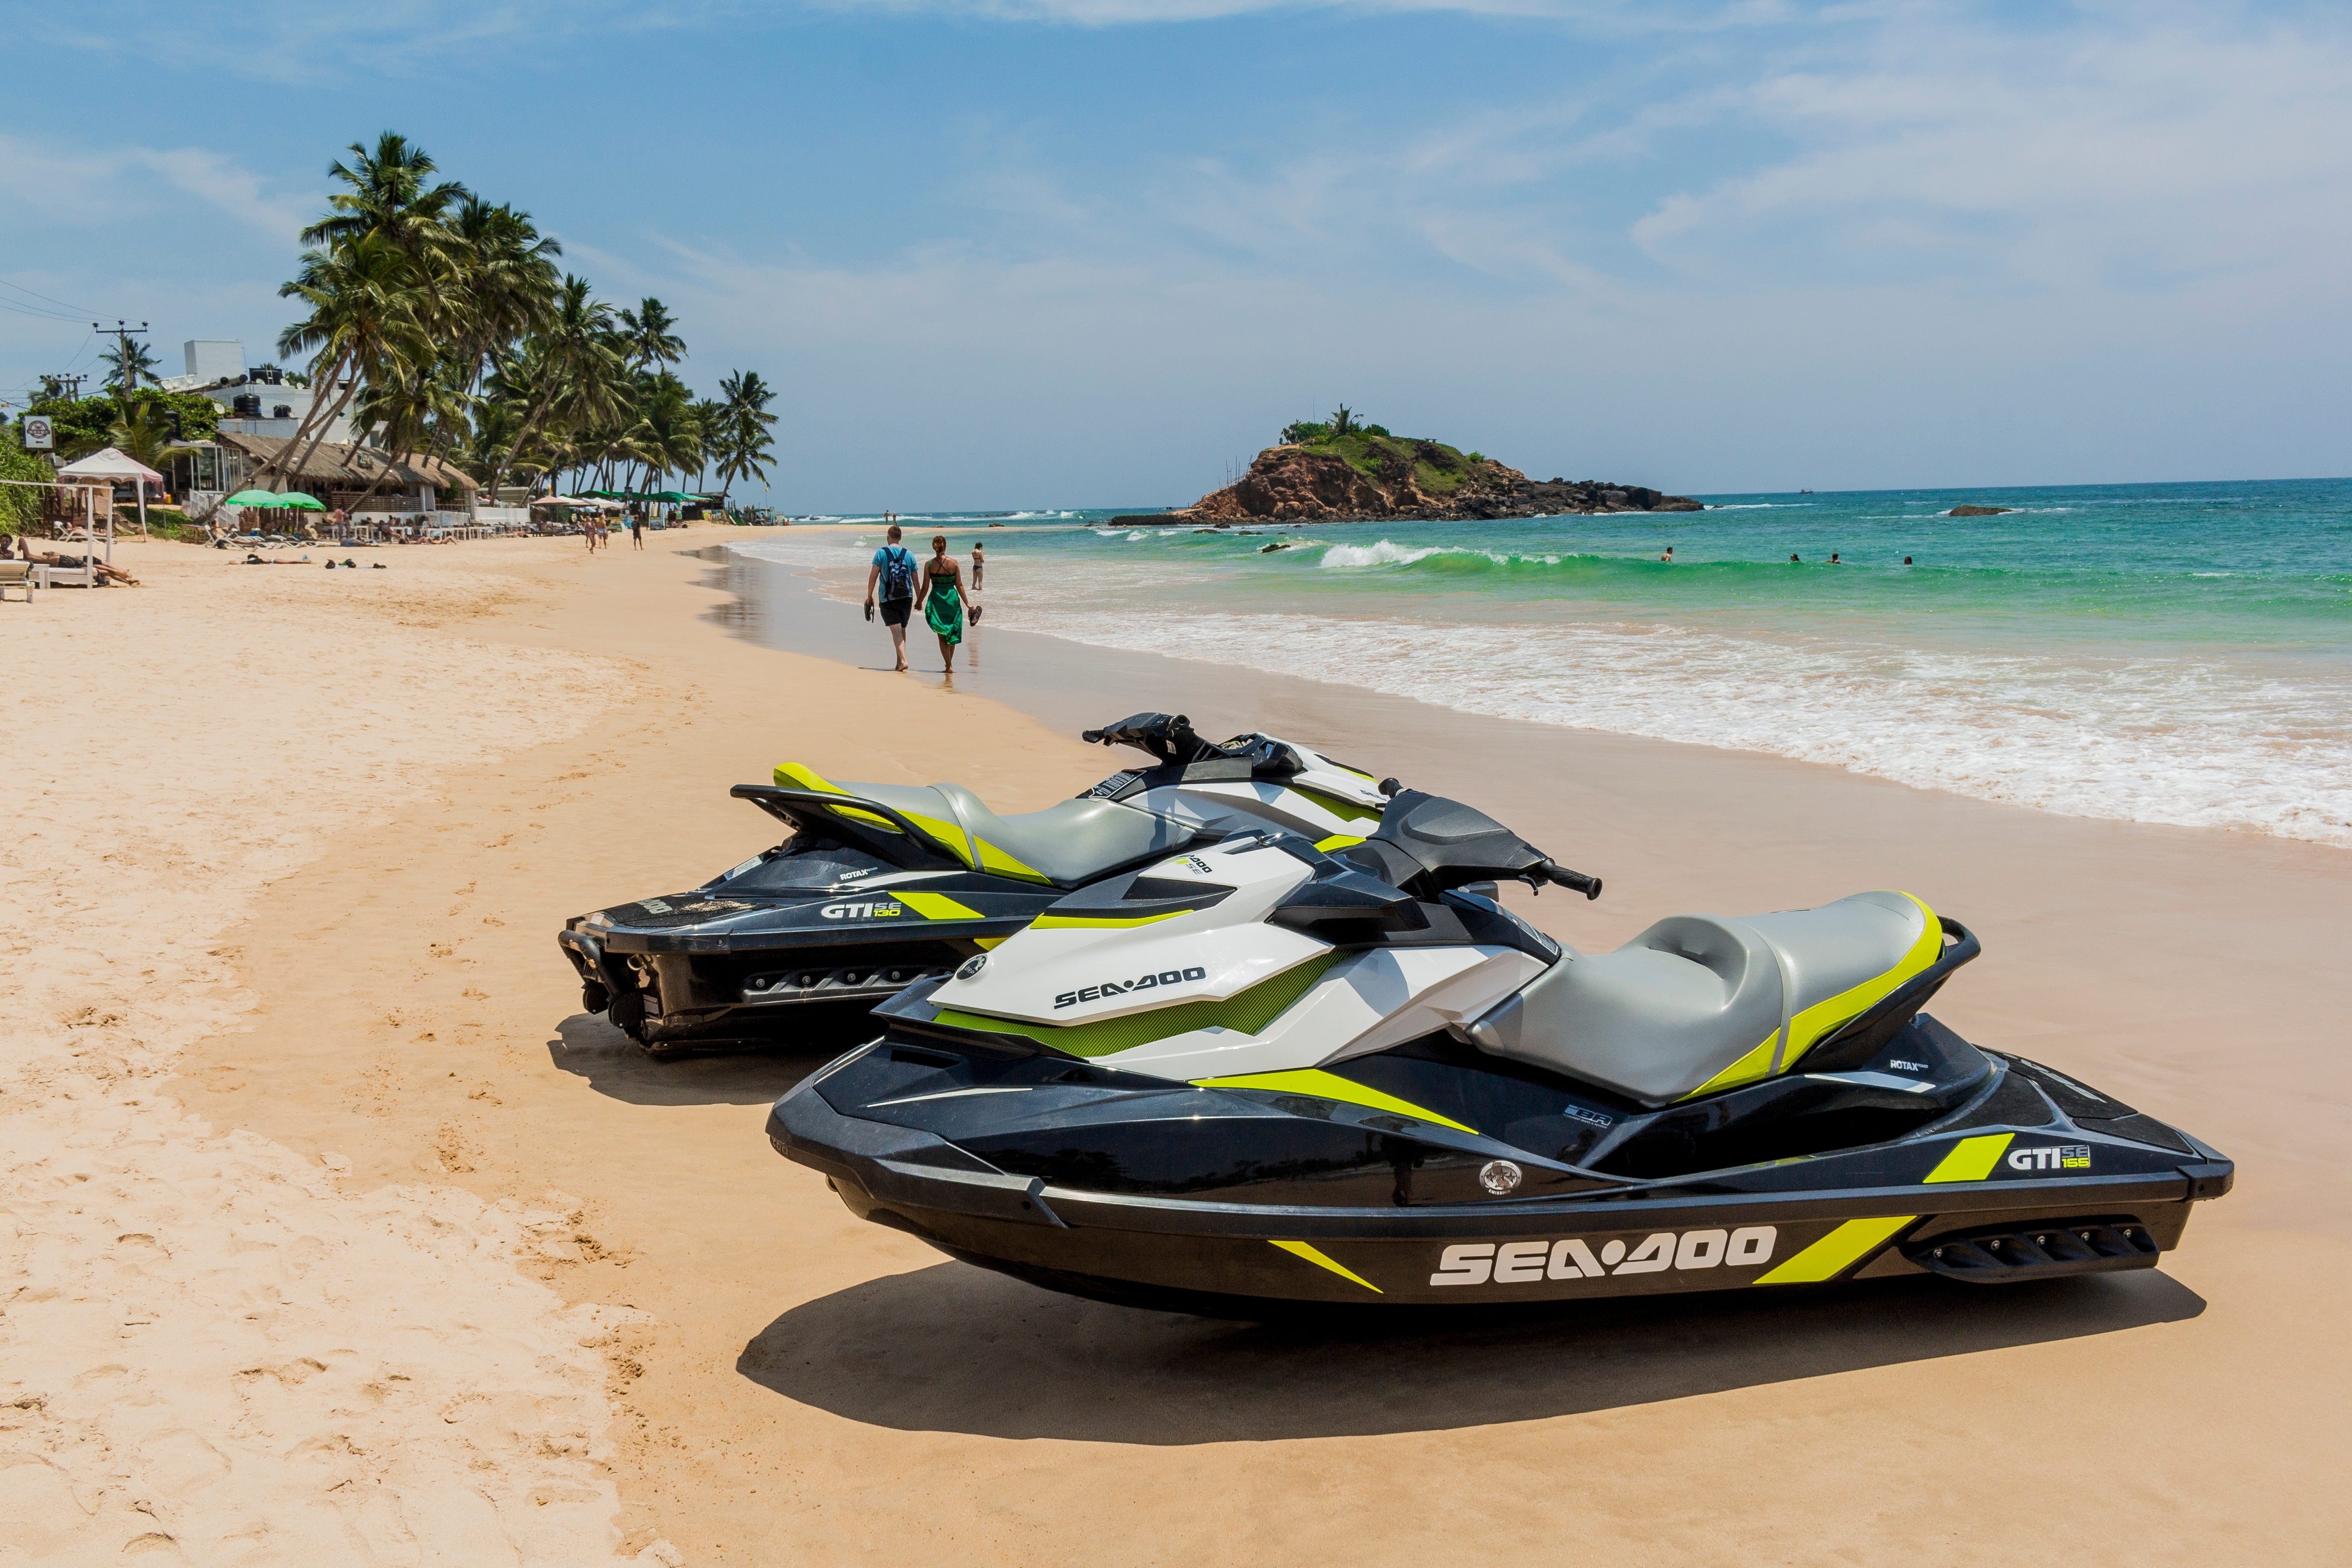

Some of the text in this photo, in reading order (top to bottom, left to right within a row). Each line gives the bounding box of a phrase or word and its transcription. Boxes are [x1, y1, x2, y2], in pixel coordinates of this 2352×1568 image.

[840, 869, 868, 880] ROTAX
[821, 903, 873, 918] GTI
[1890, 1059, 1919, 1071] ROTAX
[2008, 1147, 2088, 1170] GTI SE
[2062, 1157, 2089, 1168] 155
